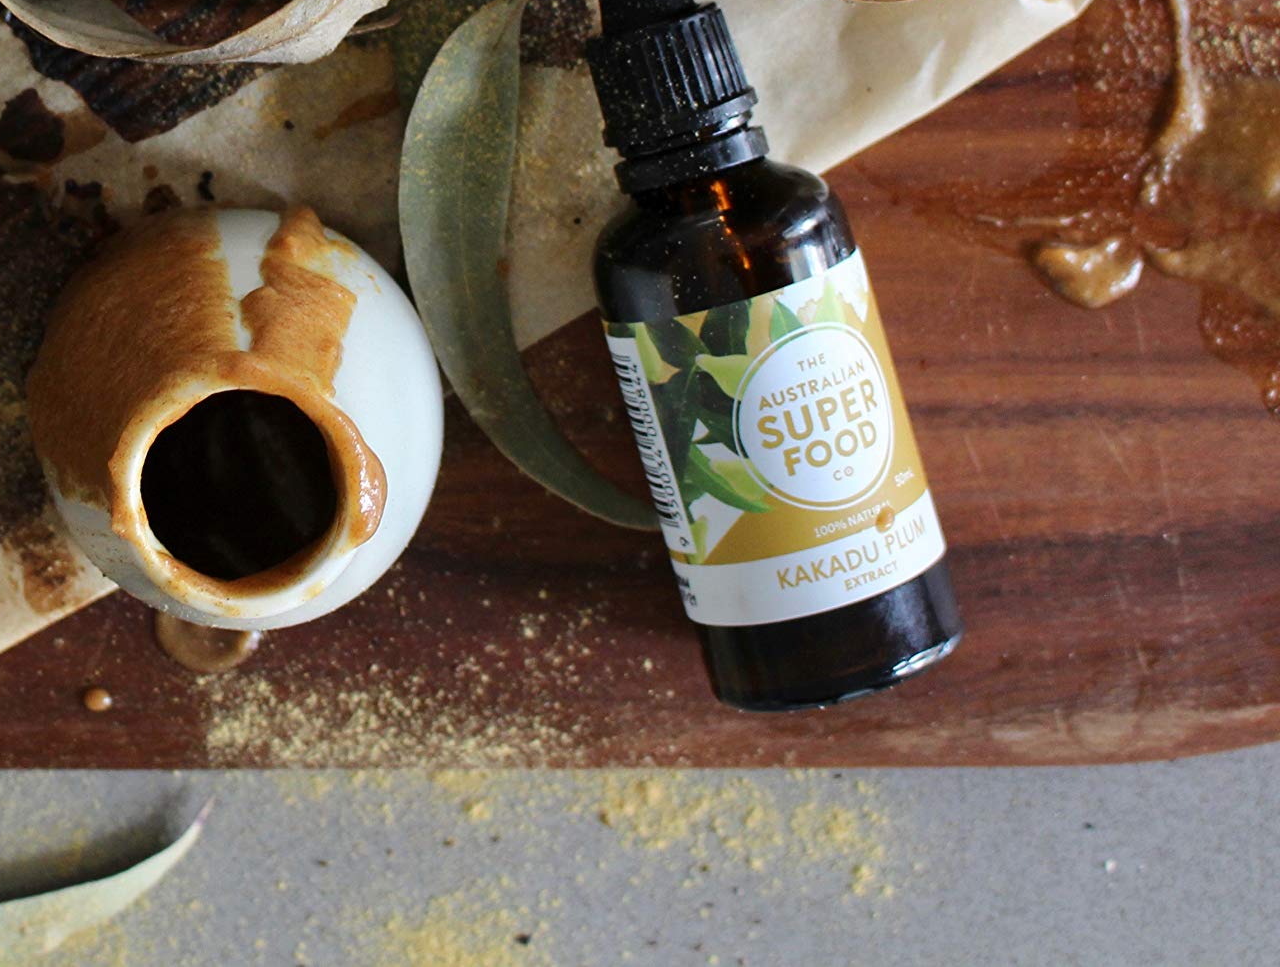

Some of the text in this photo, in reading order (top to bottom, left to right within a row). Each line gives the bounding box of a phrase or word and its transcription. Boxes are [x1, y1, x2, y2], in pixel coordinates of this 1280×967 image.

[797, 353, 826, 372] THE
[758, 359, 865, 411] AUSTRALIAN
[757, 378, 878, 450] SUPER
[783, 420, 877, 477] FOOD
[833, 466, 854, 481] CO
[814, 500, 891, 538] 100% NATUR
[679, 536, 689, 547] 9
[776, 515, 926, 590] KAKADU PLUM
[844, 560, 898, 591] EXTRACT
